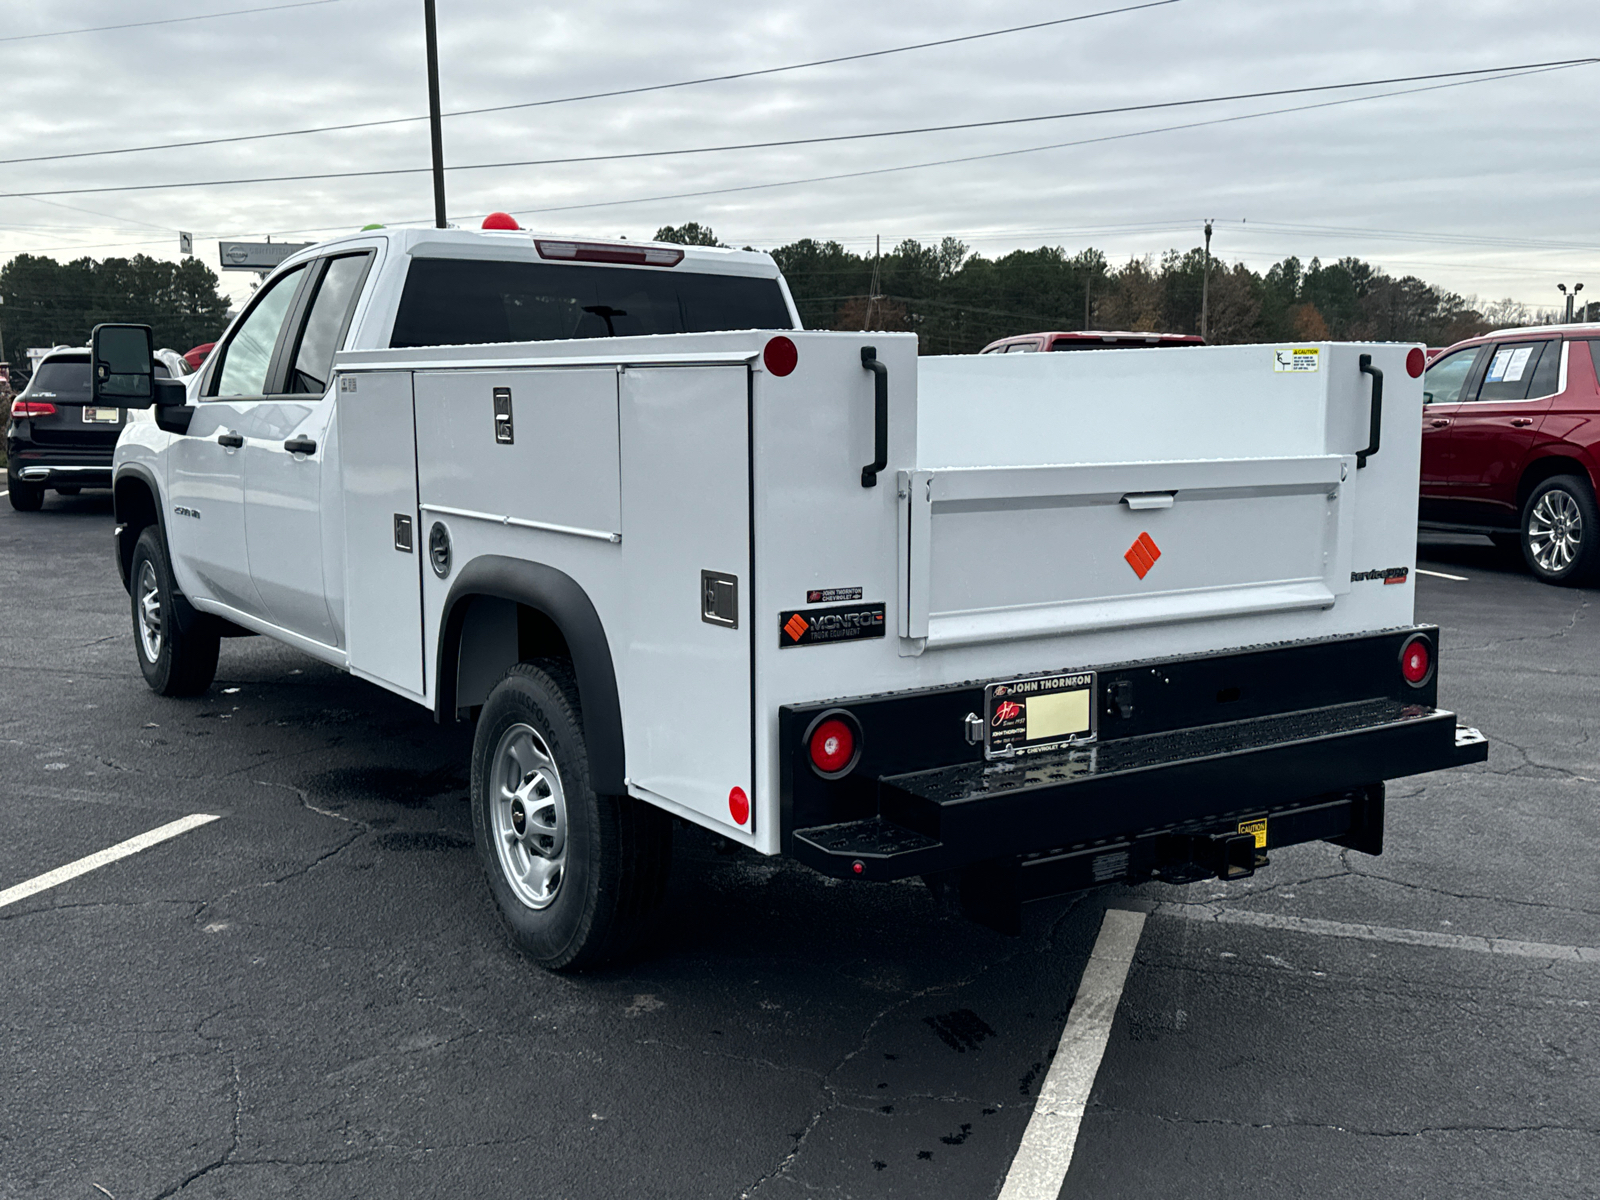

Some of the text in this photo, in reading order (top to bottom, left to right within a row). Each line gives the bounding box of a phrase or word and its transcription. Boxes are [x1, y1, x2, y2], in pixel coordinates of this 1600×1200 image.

[822, 594, 852, 602] CHEVROLET
[810, 610, 883, 631] MONROE
[810, 627, 861, 640] TRUCK EQUIPMENT
[1011, 681, 1038, 694] JOHN
[1040, 675, 1092, 691] THORNTON
[1026, 744, 1059, 755] CHEVROLET
[1241, 823, 1265, 834] CAUTION
